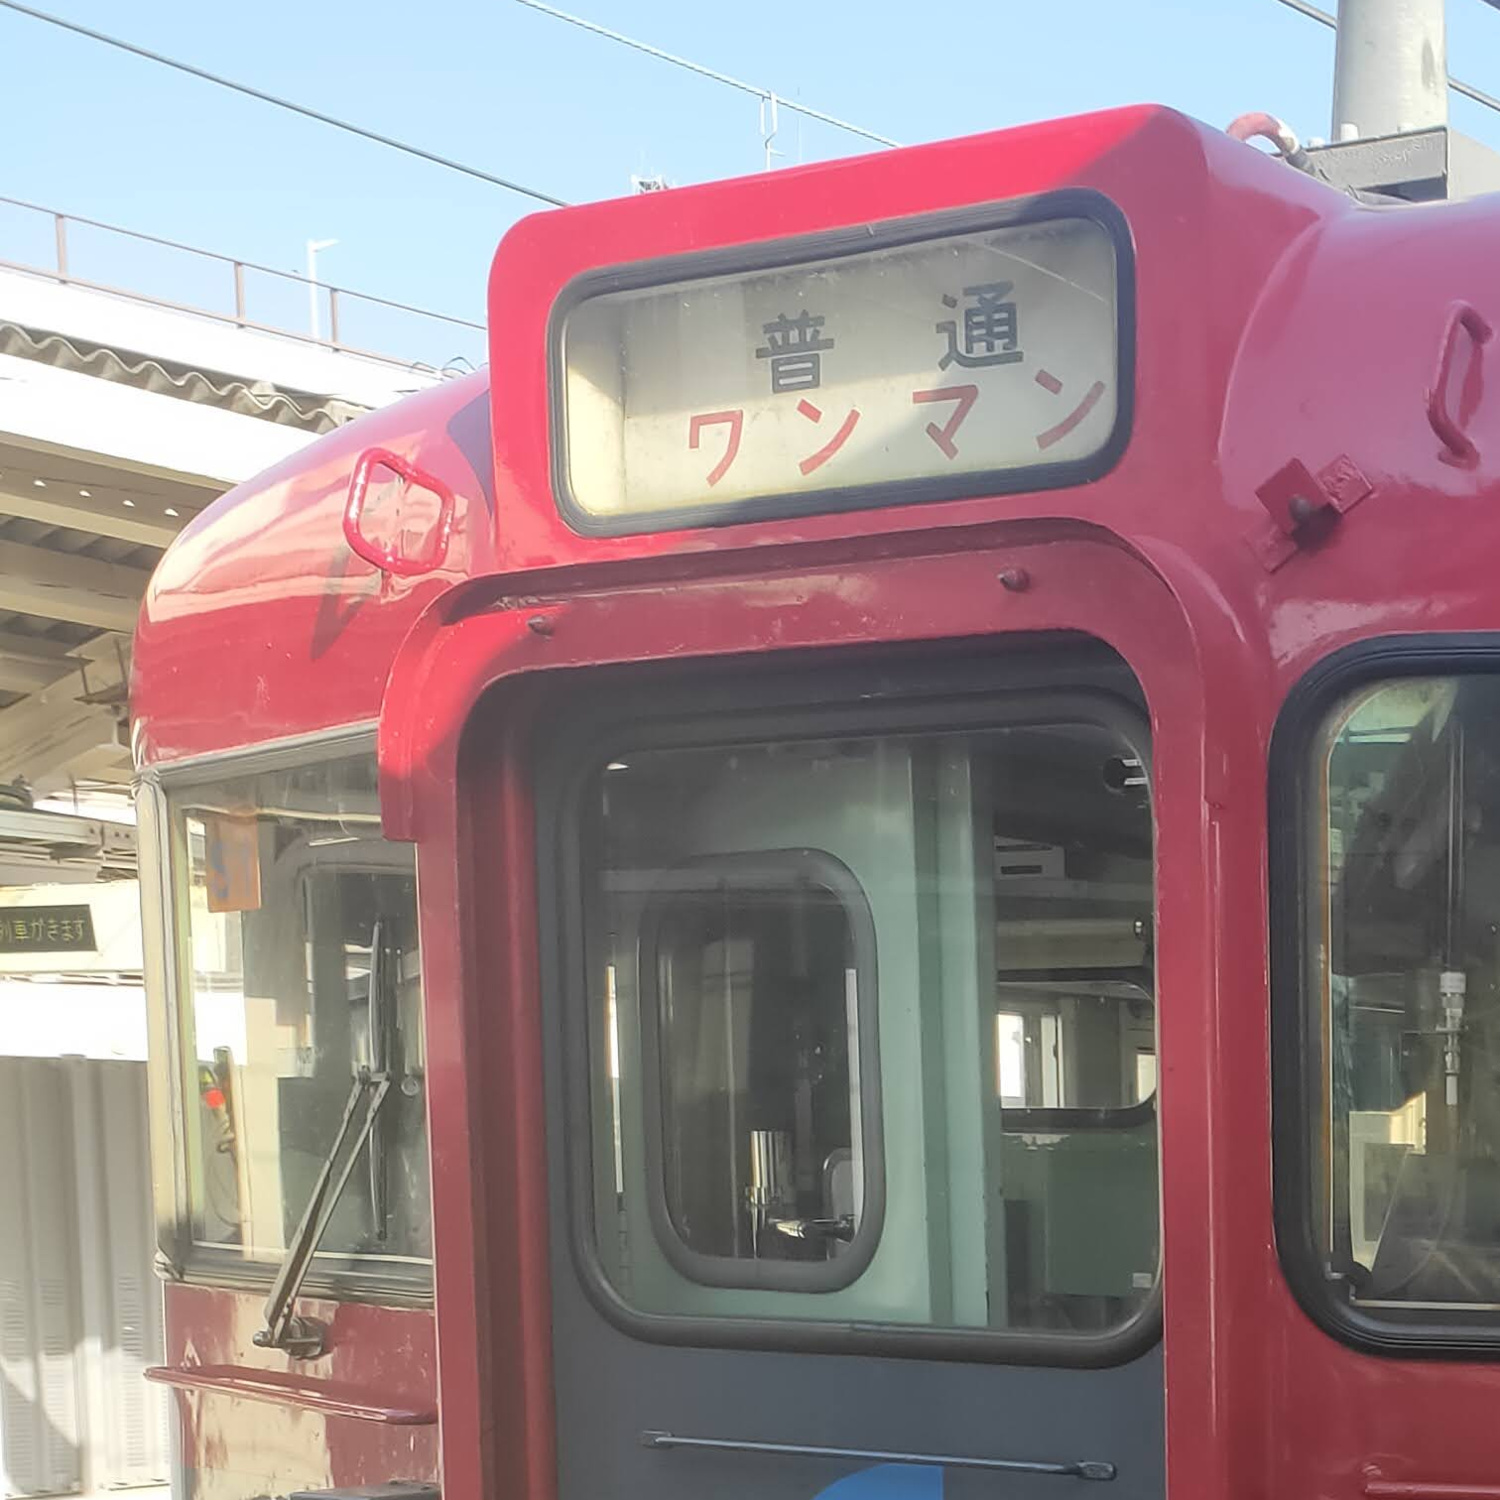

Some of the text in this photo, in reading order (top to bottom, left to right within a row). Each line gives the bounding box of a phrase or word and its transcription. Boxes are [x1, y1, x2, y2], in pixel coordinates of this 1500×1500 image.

[755, 280, 1024, 394] 普通
[688, 368, 1106, 487] ワンマン
